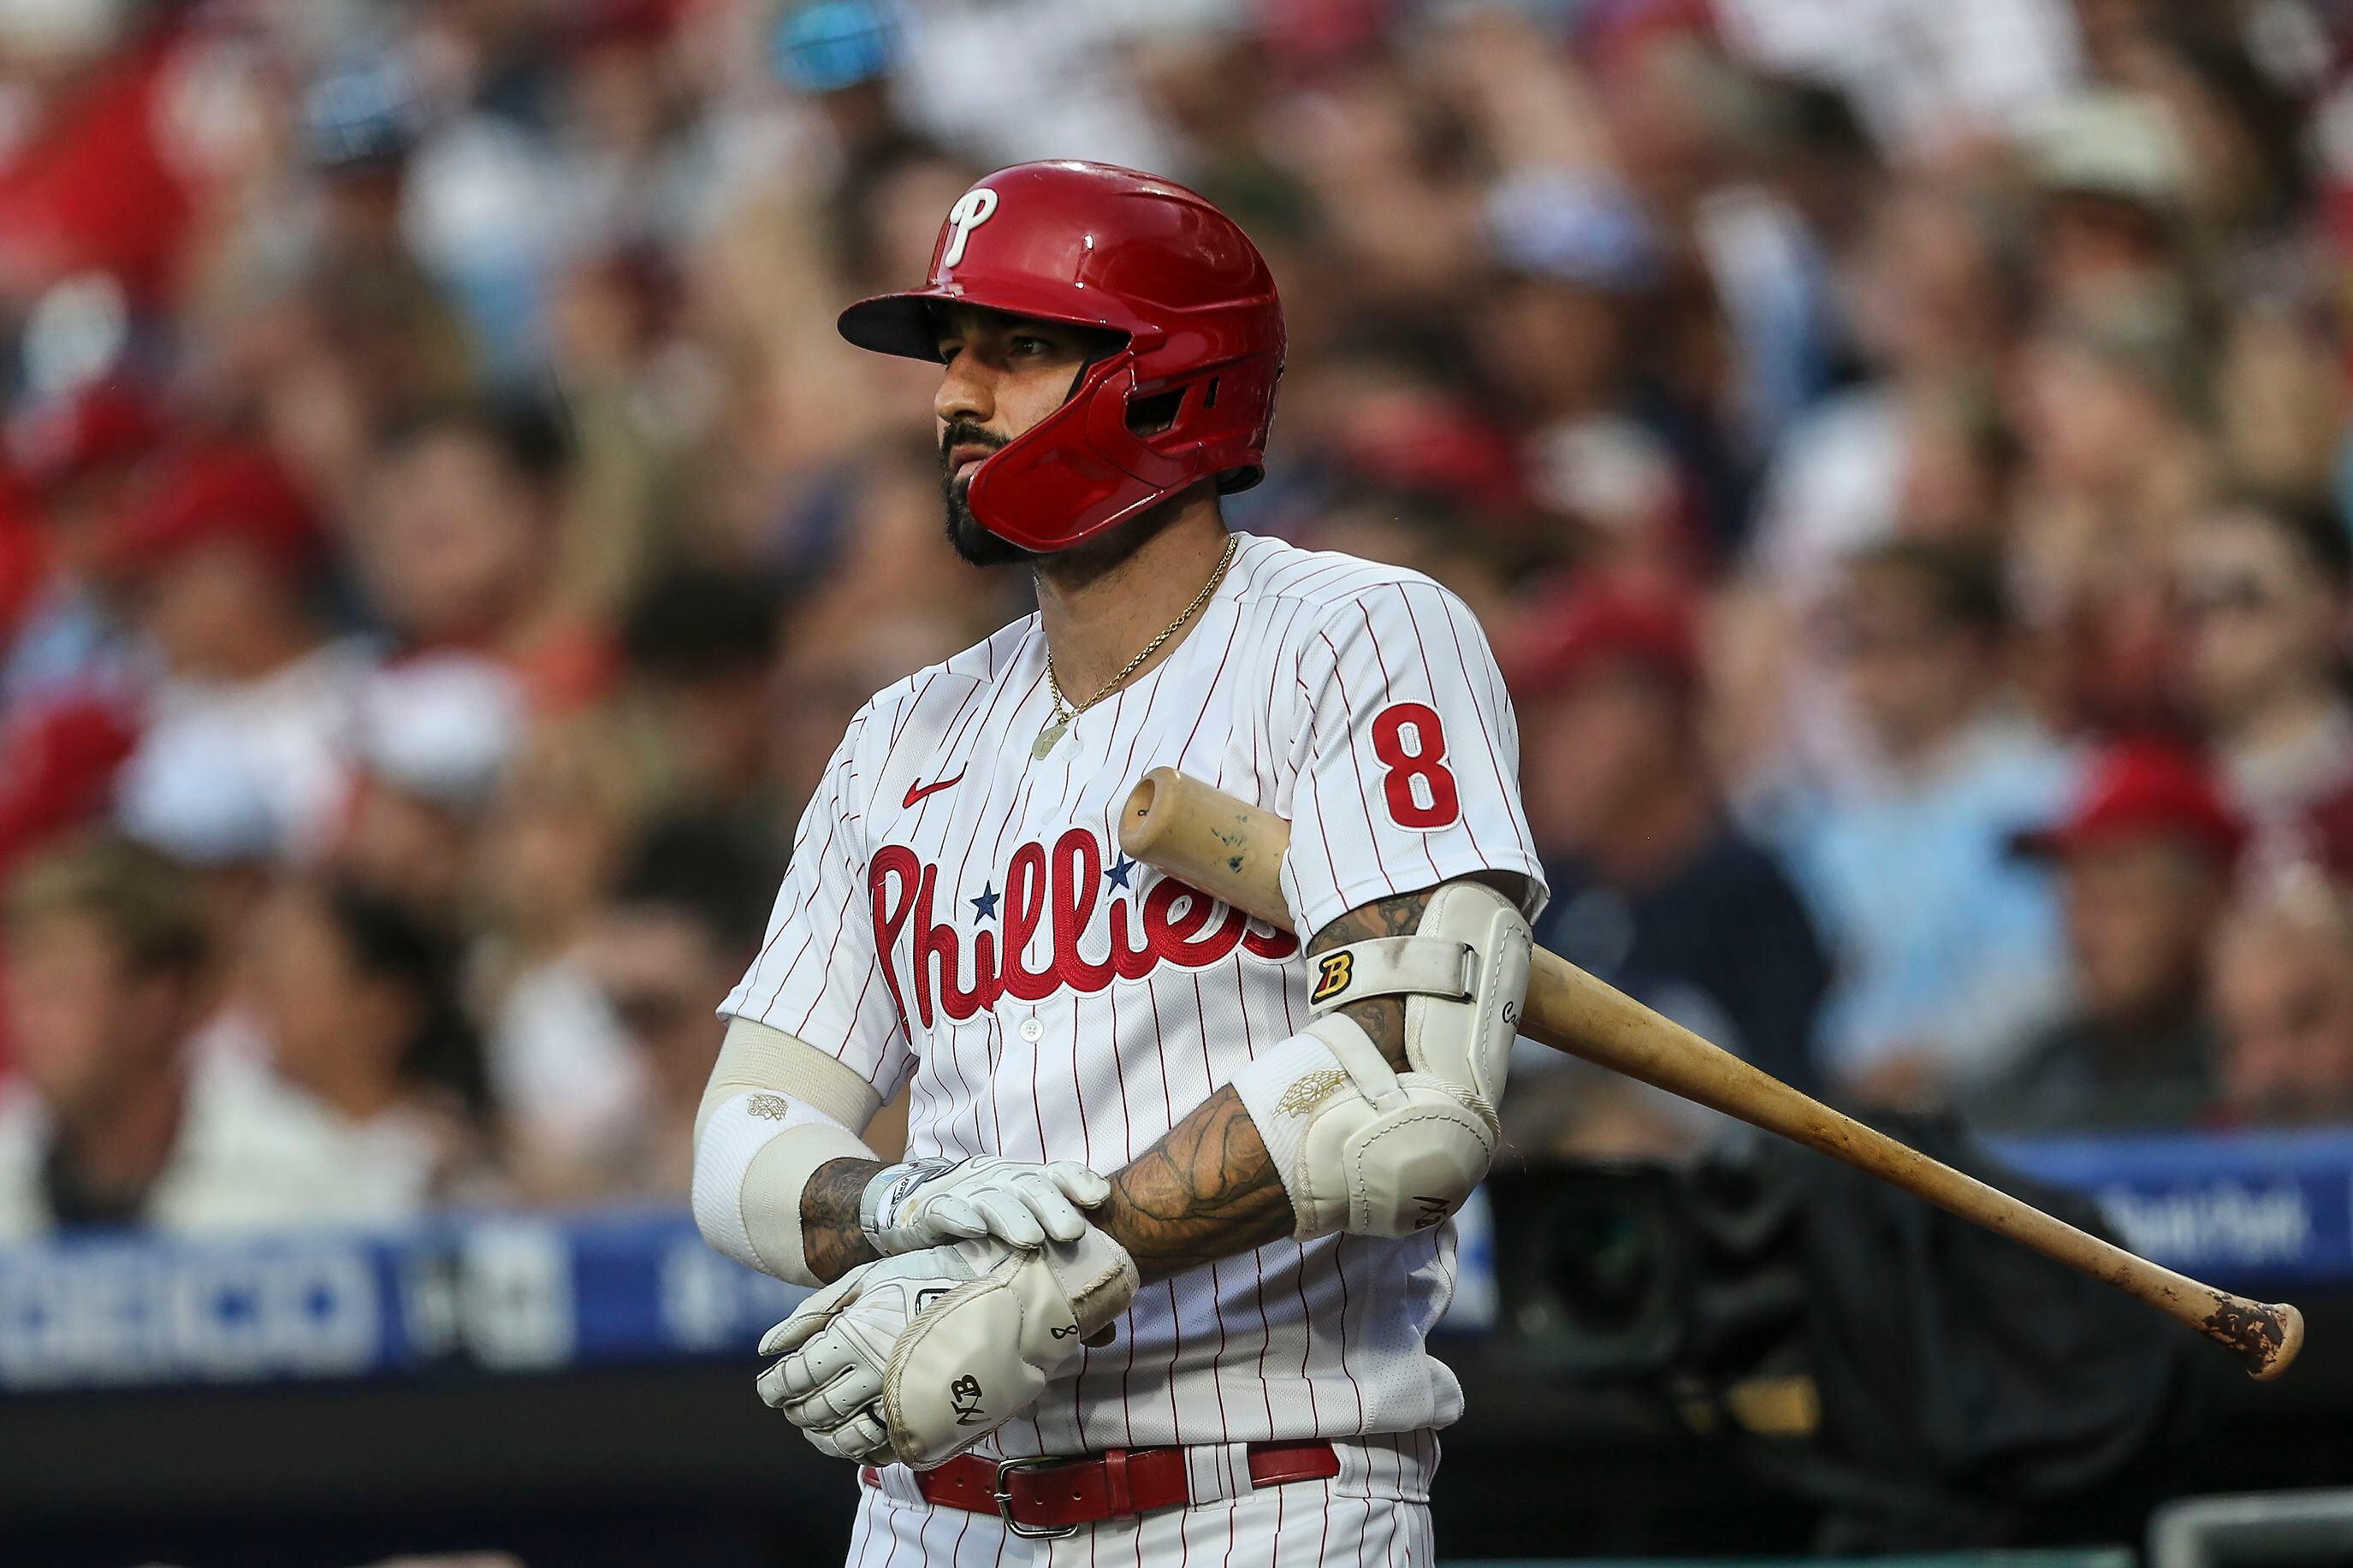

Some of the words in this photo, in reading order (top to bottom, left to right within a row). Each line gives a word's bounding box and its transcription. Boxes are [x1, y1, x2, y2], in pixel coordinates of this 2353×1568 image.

[945, 187, 999, 269] P
[1371, 701, 1461, 830] 8
[1311, 950, 1354, 1005] B
[1051, 1325, 1078, 1340] 8
